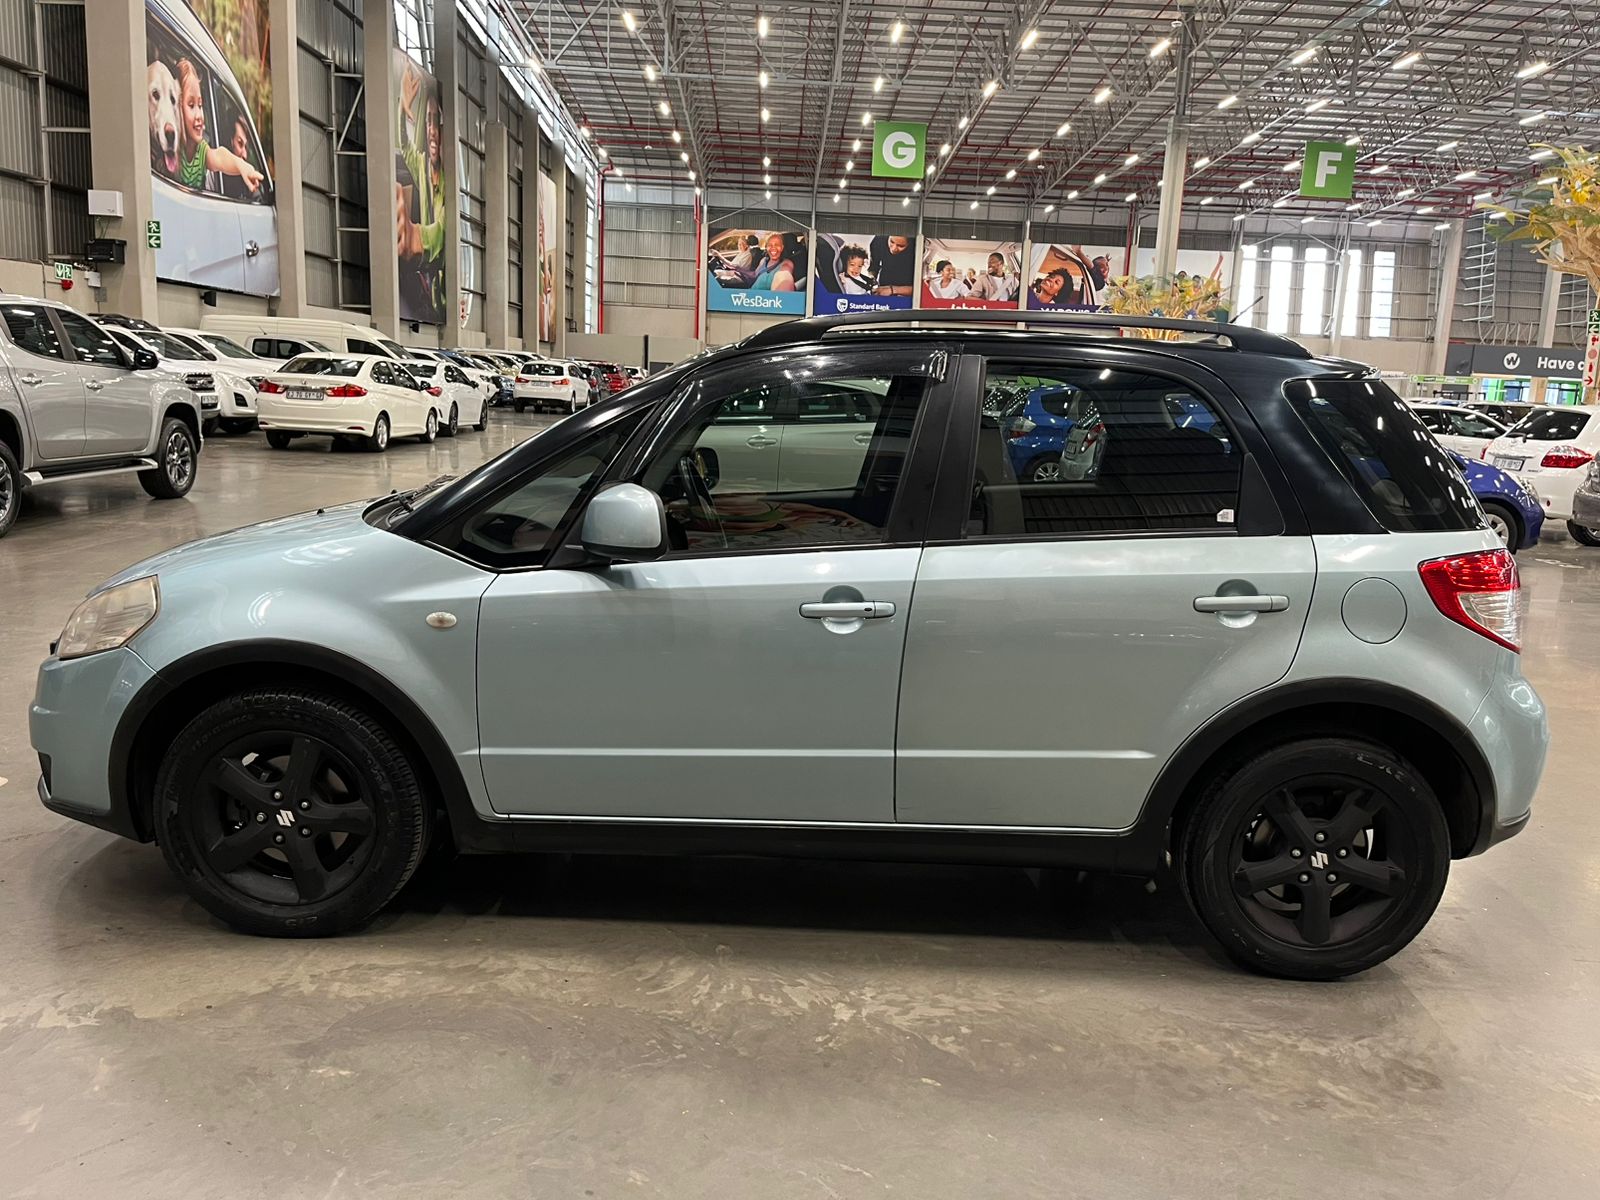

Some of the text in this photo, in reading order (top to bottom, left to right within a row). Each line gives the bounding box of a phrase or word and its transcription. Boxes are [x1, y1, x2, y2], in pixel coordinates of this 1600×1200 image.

[882, 131, 916, 169] G
[1314, 151, 1343, 188] F
[731, 293, 783, 309] WesBank
[849, 302, 875, 310] Standard
[1537, 356, 1575, 370] Have
